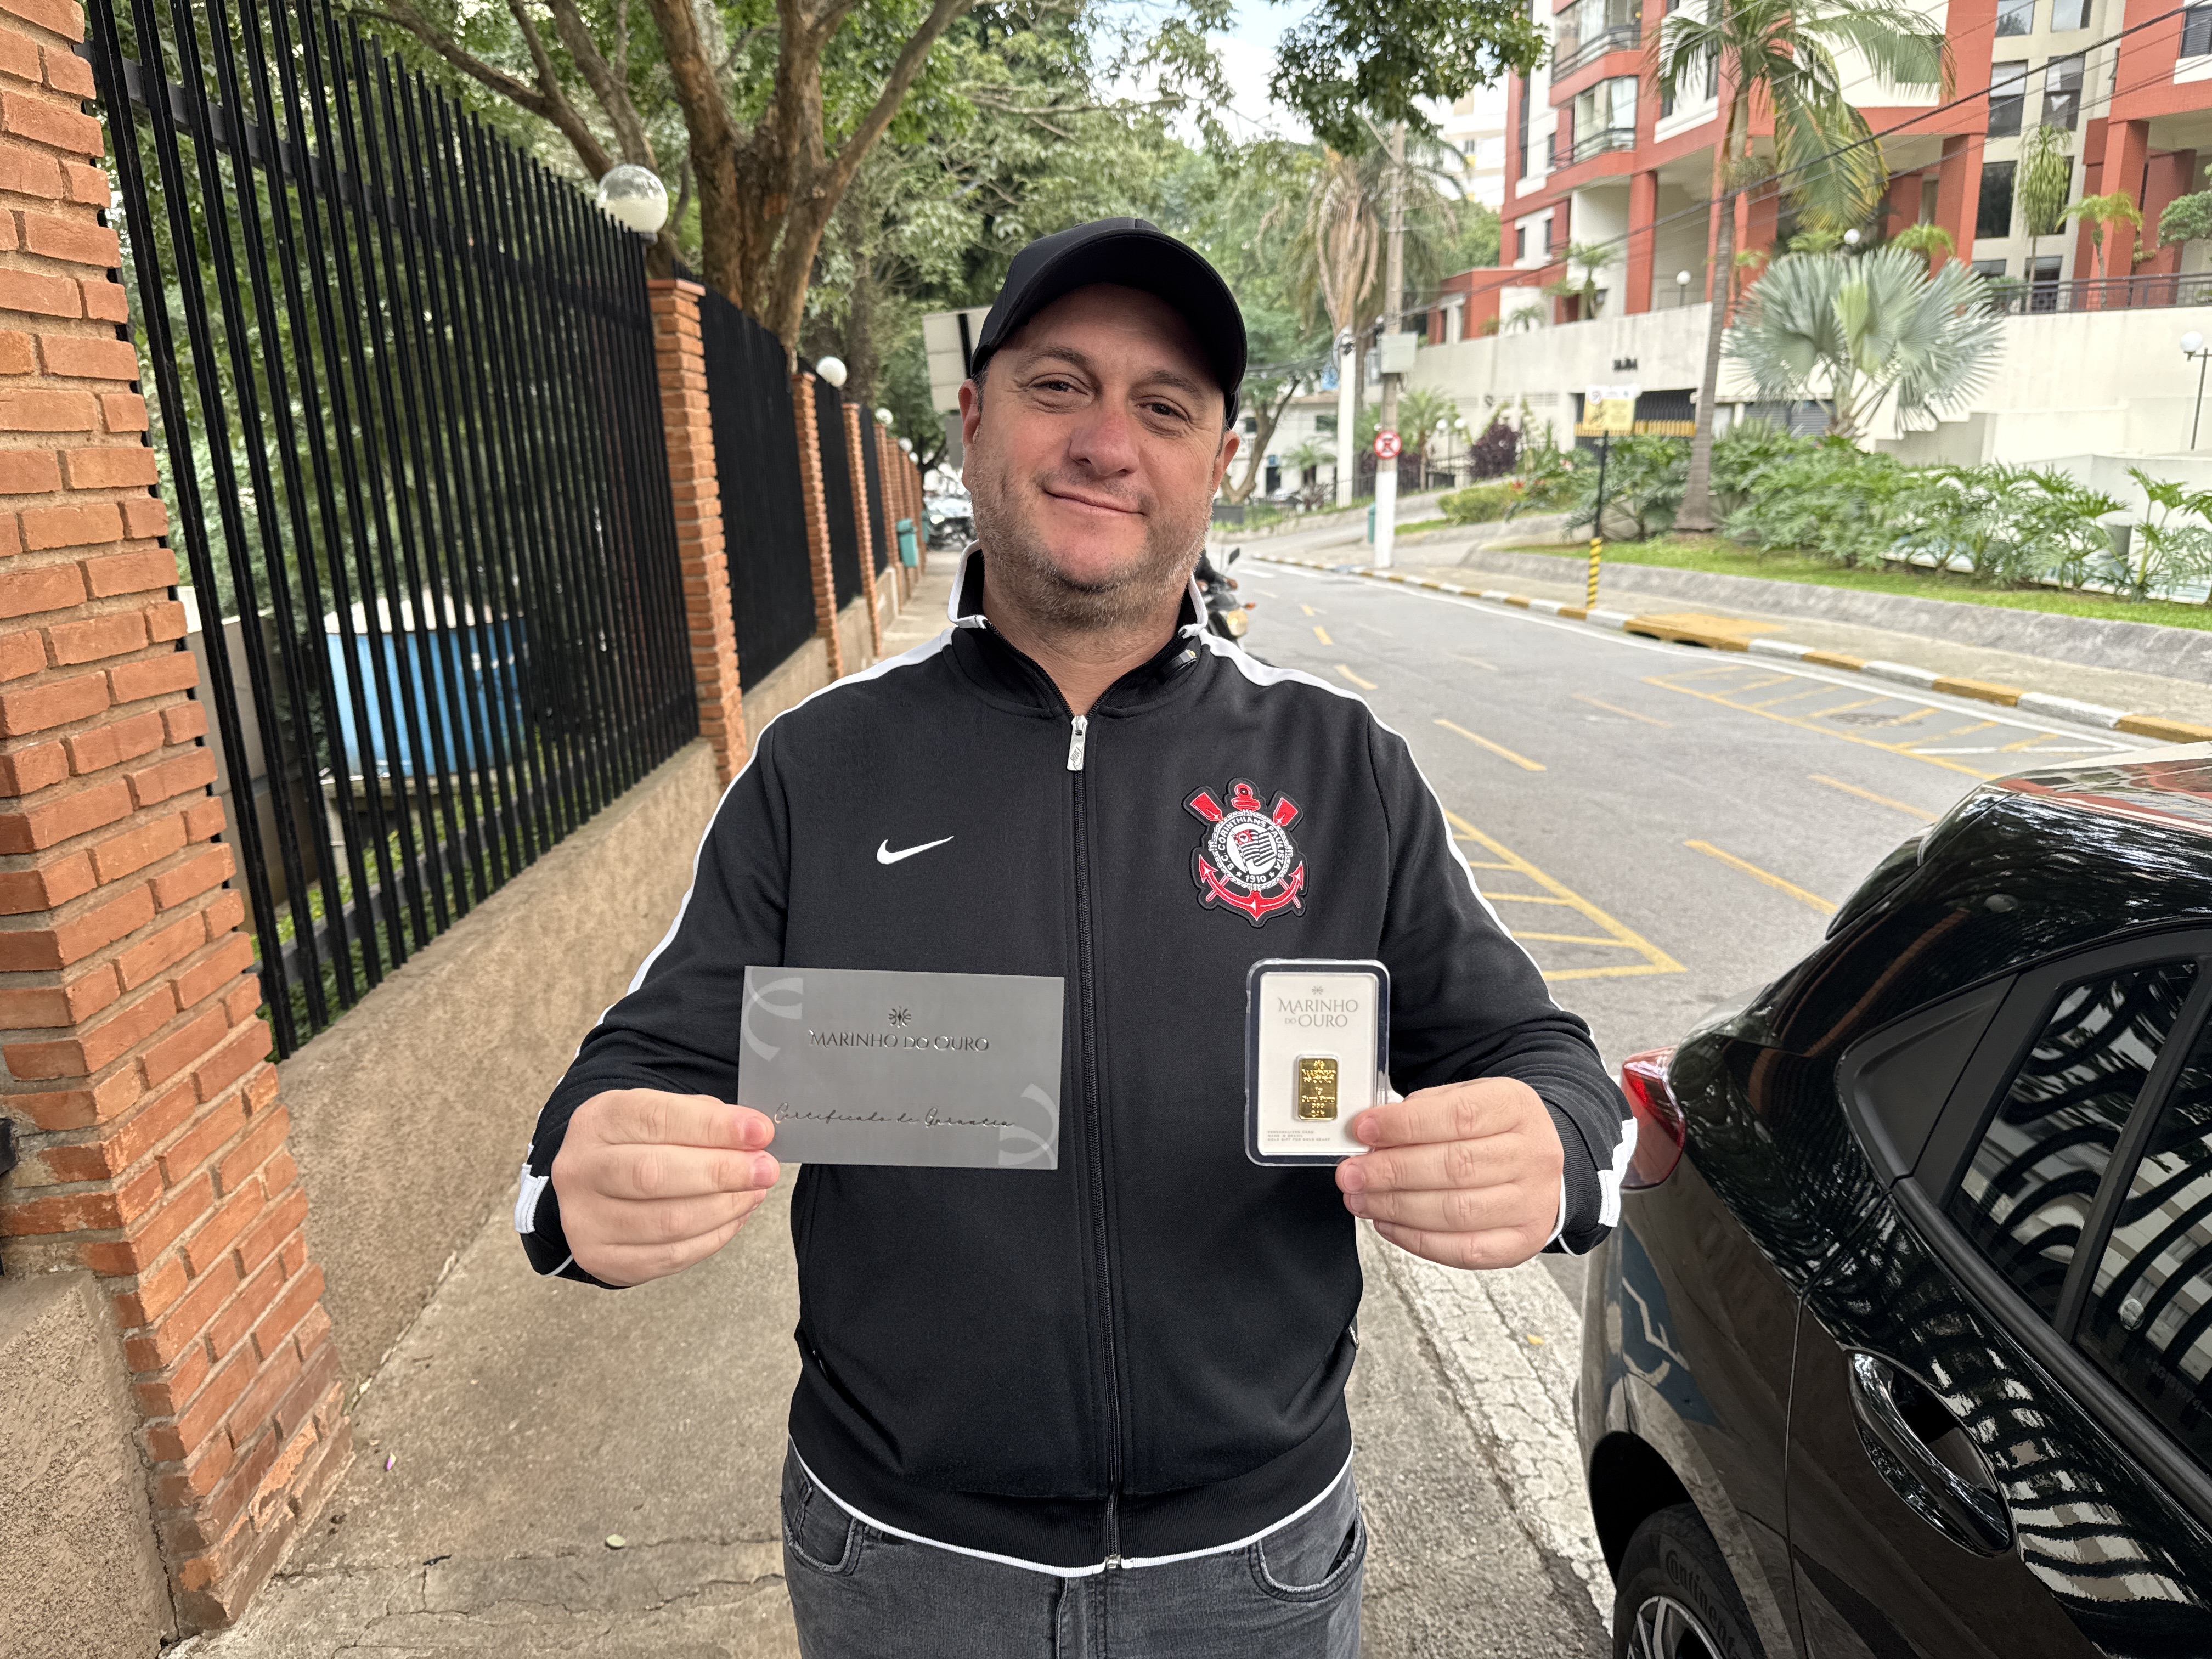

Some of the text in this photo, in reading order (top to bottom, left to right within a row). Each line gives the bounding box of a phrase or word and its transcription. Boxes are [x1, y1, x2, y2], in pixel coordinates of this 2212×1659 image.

[1070, 746, 1083, 763] NIKE
[1217, 816, 1266, 851] CORINTHIANS
[1267, 827, 1285, 870] PAULISTA
[1245, 874, 1266, 883] 1910
[1277, 997, 1358, 1014] MARINHO
[1298, 1014, 1348, 1028] OURO
[809, 1030, 989, 1052] MARINHO DO OURO
[774, 1102, 1015, 1128] Certificado de Garantia
[1666, 1549, 1741, 1659] Continent
